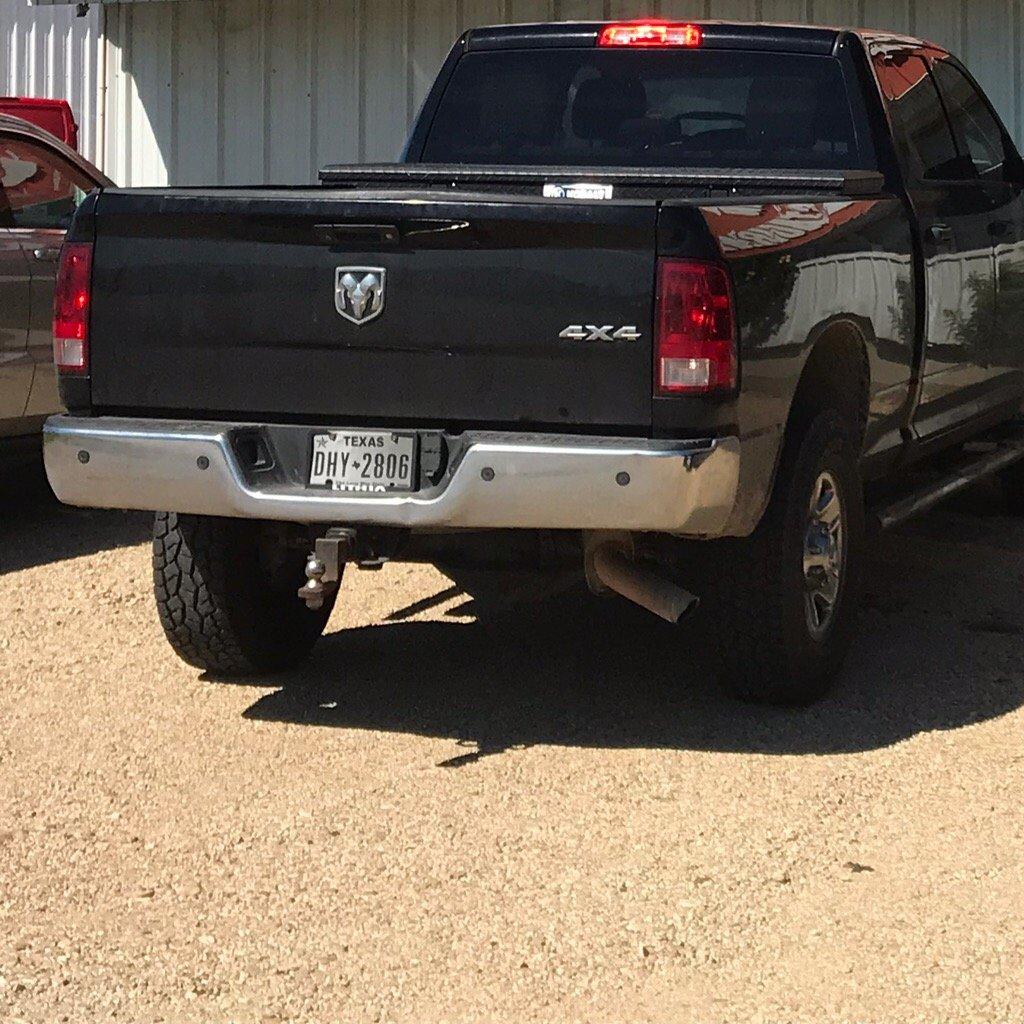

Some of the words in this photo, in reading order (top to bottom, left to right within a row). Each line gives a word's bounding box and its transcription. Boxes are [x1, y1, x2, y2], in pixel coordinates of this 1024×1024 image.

[558, 325, 642, 341] 4X4
[344, 436, 384, 448] TEXAS
[313, 451, 350, 477] DHY
[360, 453, 409, 479] 2806
